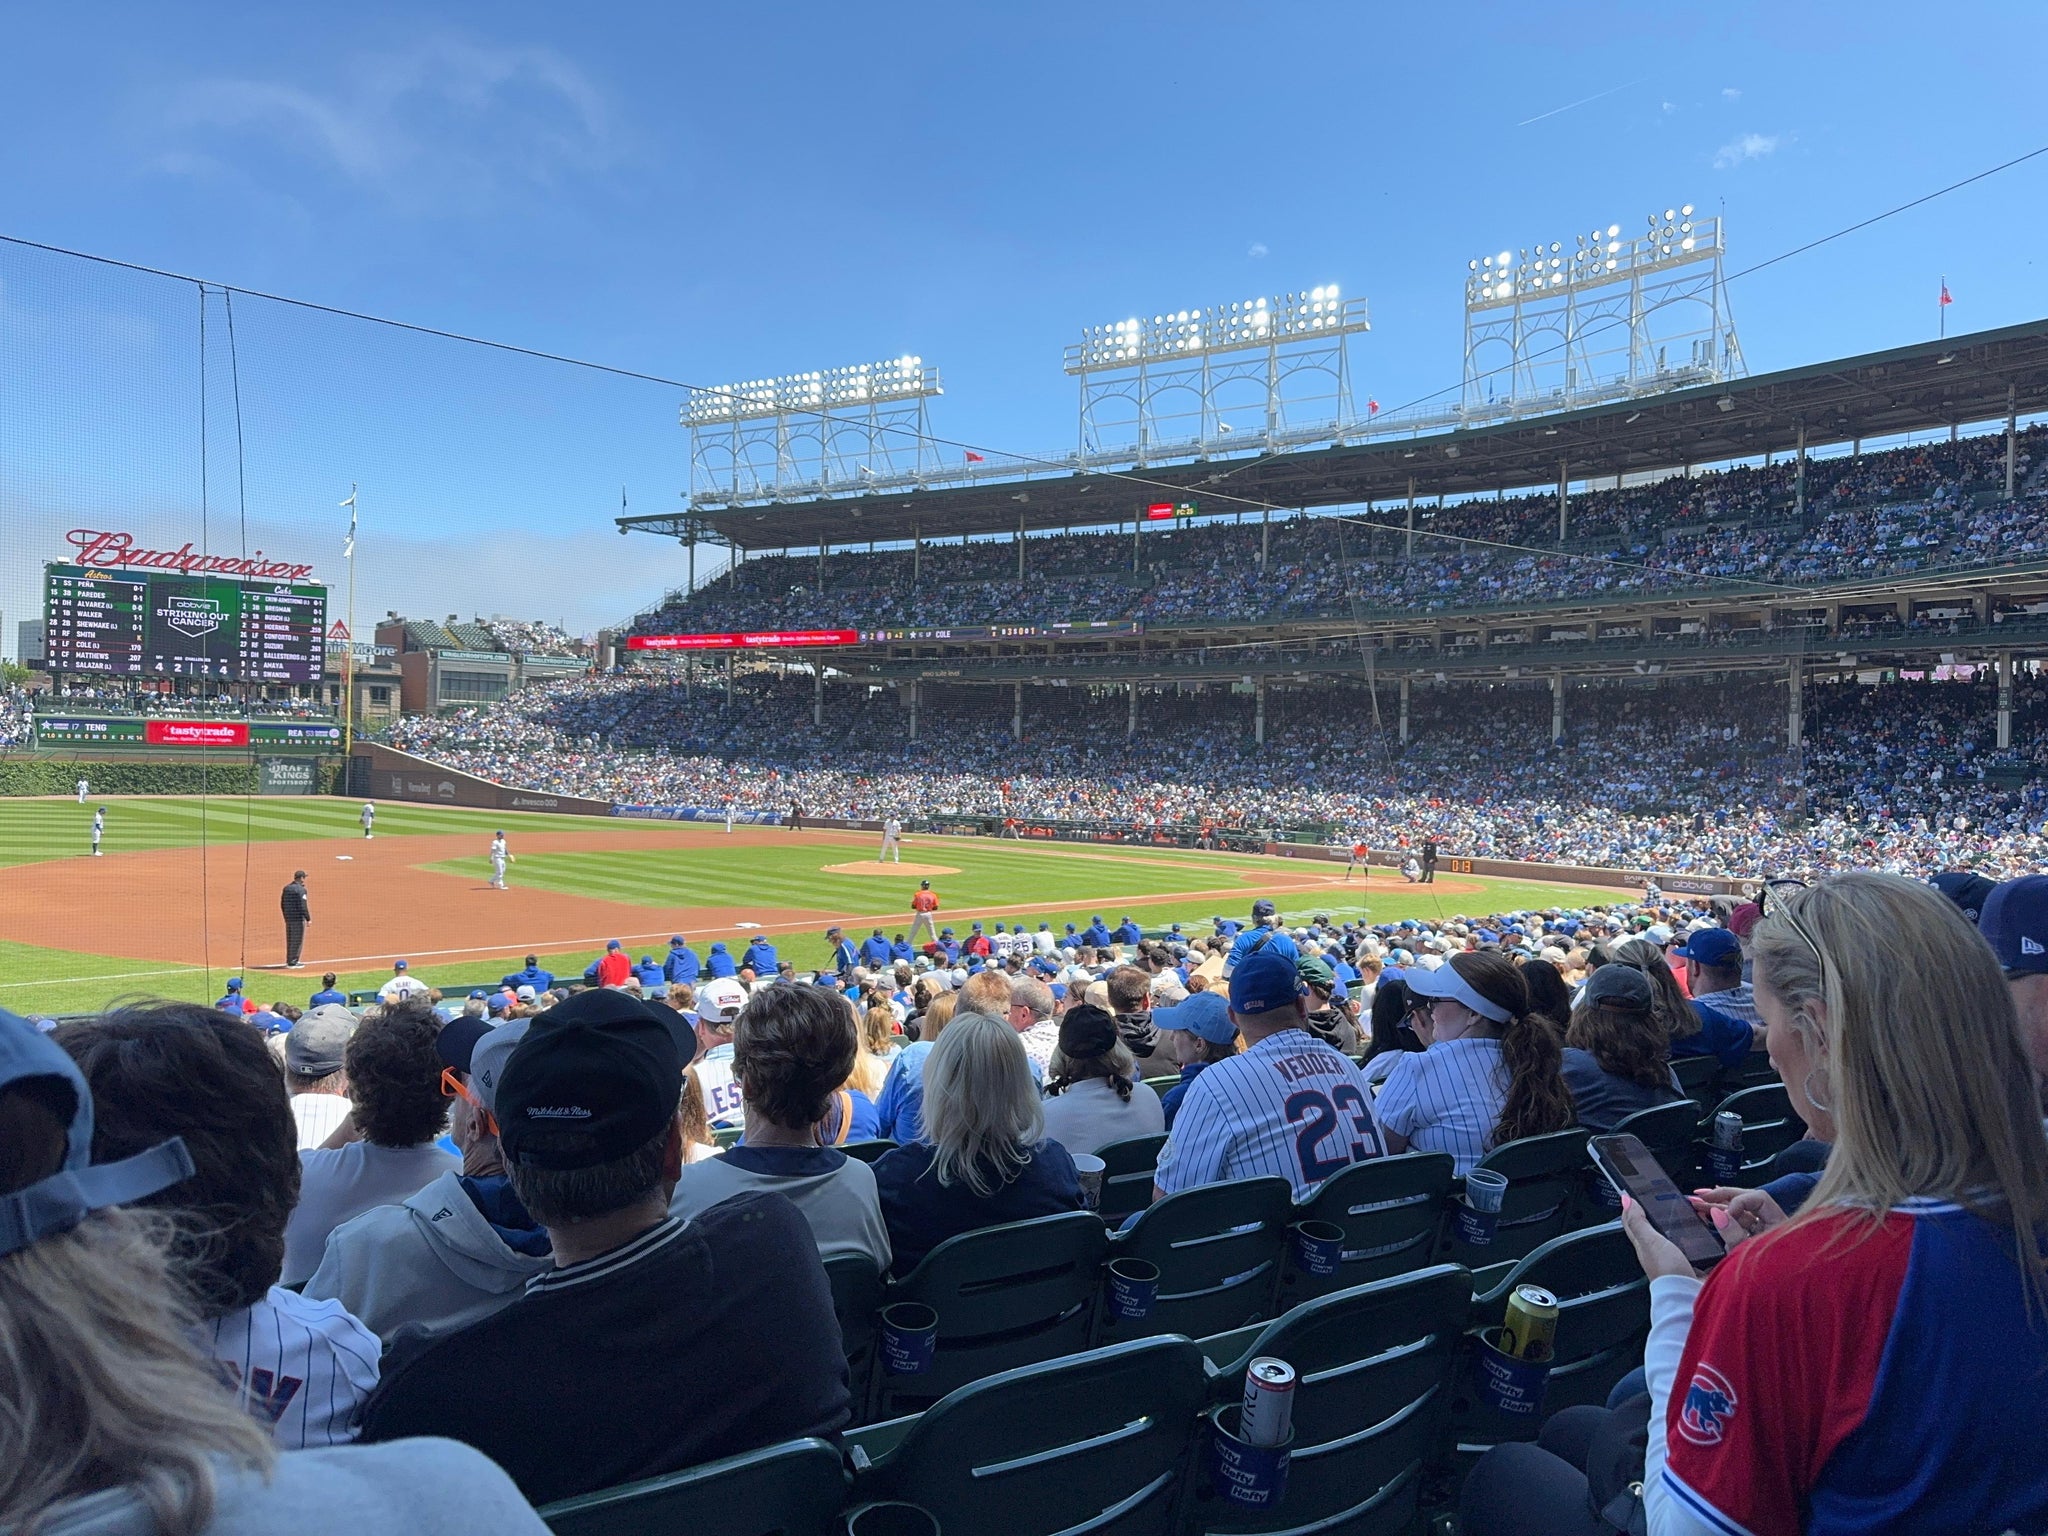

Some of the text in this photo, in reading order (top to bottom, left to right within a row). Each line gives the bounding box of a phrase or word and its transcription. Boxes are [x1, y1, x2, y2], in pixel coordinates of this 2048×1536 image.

[66, 529, 313, 580] Budweiser
[84, 570, 113, 580] Astros
[274, 586, 292, 594] Cubs
[157, 609, 207, 619] STRIKING
[76, 621, 109, 629] SHEWMAKE
[172, 618, 214, 627] CANCER
[646, 638, 678, 646] tastytrade
[746, 635, 781, 644] tastytrade
[352, 643, 398, 656] Moore
[264, 652, 300, 660] BALLESTEROS
[442, 652, 507, 661] WRIGLEYROOFTOPS.COM
[155, 662, 228, 675] 4 2 2 4
[170, 726, 235, 737] tastytrade
[269, 764, 310, 773] DRAFT
[274, 771, 310, 780] KINGS
[522, 798, 544, 806] Invesco
[618, 808, 671, 820] Reynolds Wrap
[1452, 860, 1471, 872] 0 13
[1672, 880, 1714, 891] abbvie
[1014, 941, 1029, 952] 25
[1273, 1053, 1345, 1082] VEDDER
[527, 1106, 592, 1117] Mitchell & Ness
[1285, 1084, 1384, 1184] 23
[1121, 1306, 1146, 1317] Hefty
[892, 1359, 919, 1370] Hefty
[1490, 1379, 1524, 1398] Hefty
[1500, 1398, 1535, 1413] Hefty
[1221, 1462, 1256, 1487] Hefty
[1231, 1484, 1269, 1503] Hefty
